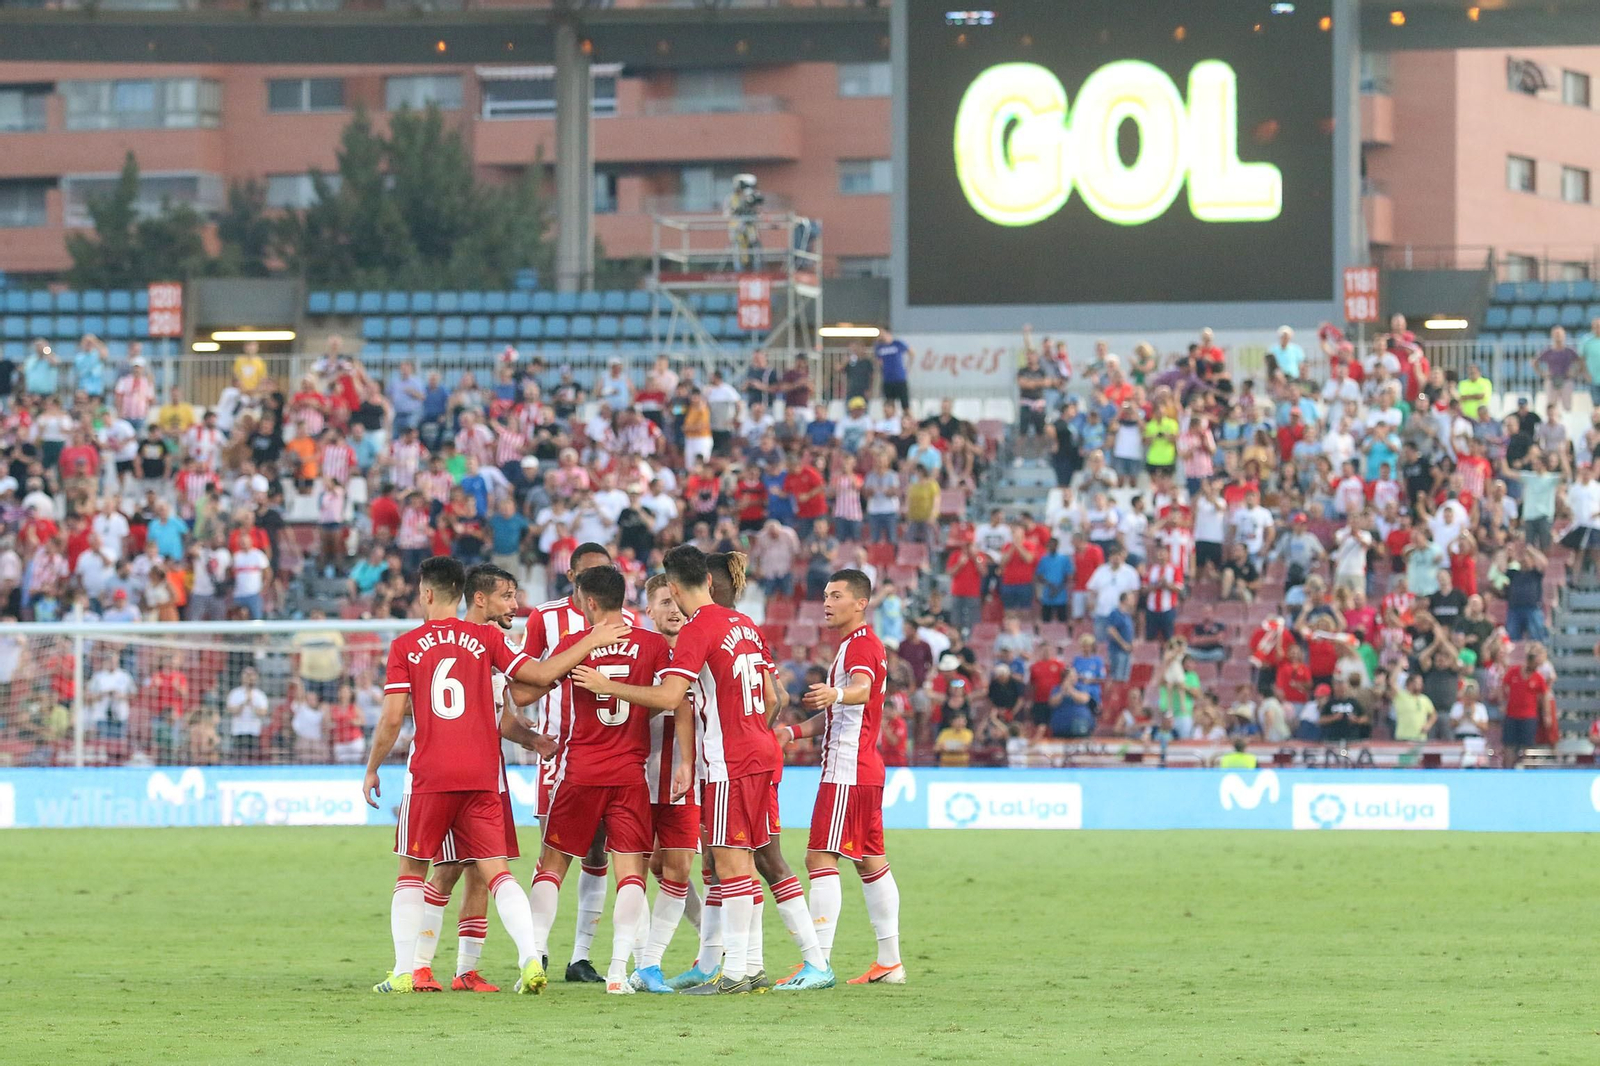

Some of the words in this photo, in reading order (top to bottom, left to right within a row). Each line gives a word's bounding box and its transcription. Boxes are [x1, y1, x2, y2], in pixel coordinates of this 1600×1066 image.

[954, 59, 1283, 226] GOL
[407, 652, 423, 665] C.
[417, 632, 437, 652] DE
[437, 630, 456, 644] LA
[458, 632, 486, 660] HOZ
[430, 656, 466, 720] 6
[596, 664, 631, 726] 5
[732, 652, 766, 717] 15
[988, 797, 1068, 820] LaLiga
[1354, 798, 1435, 822] LaLiga
